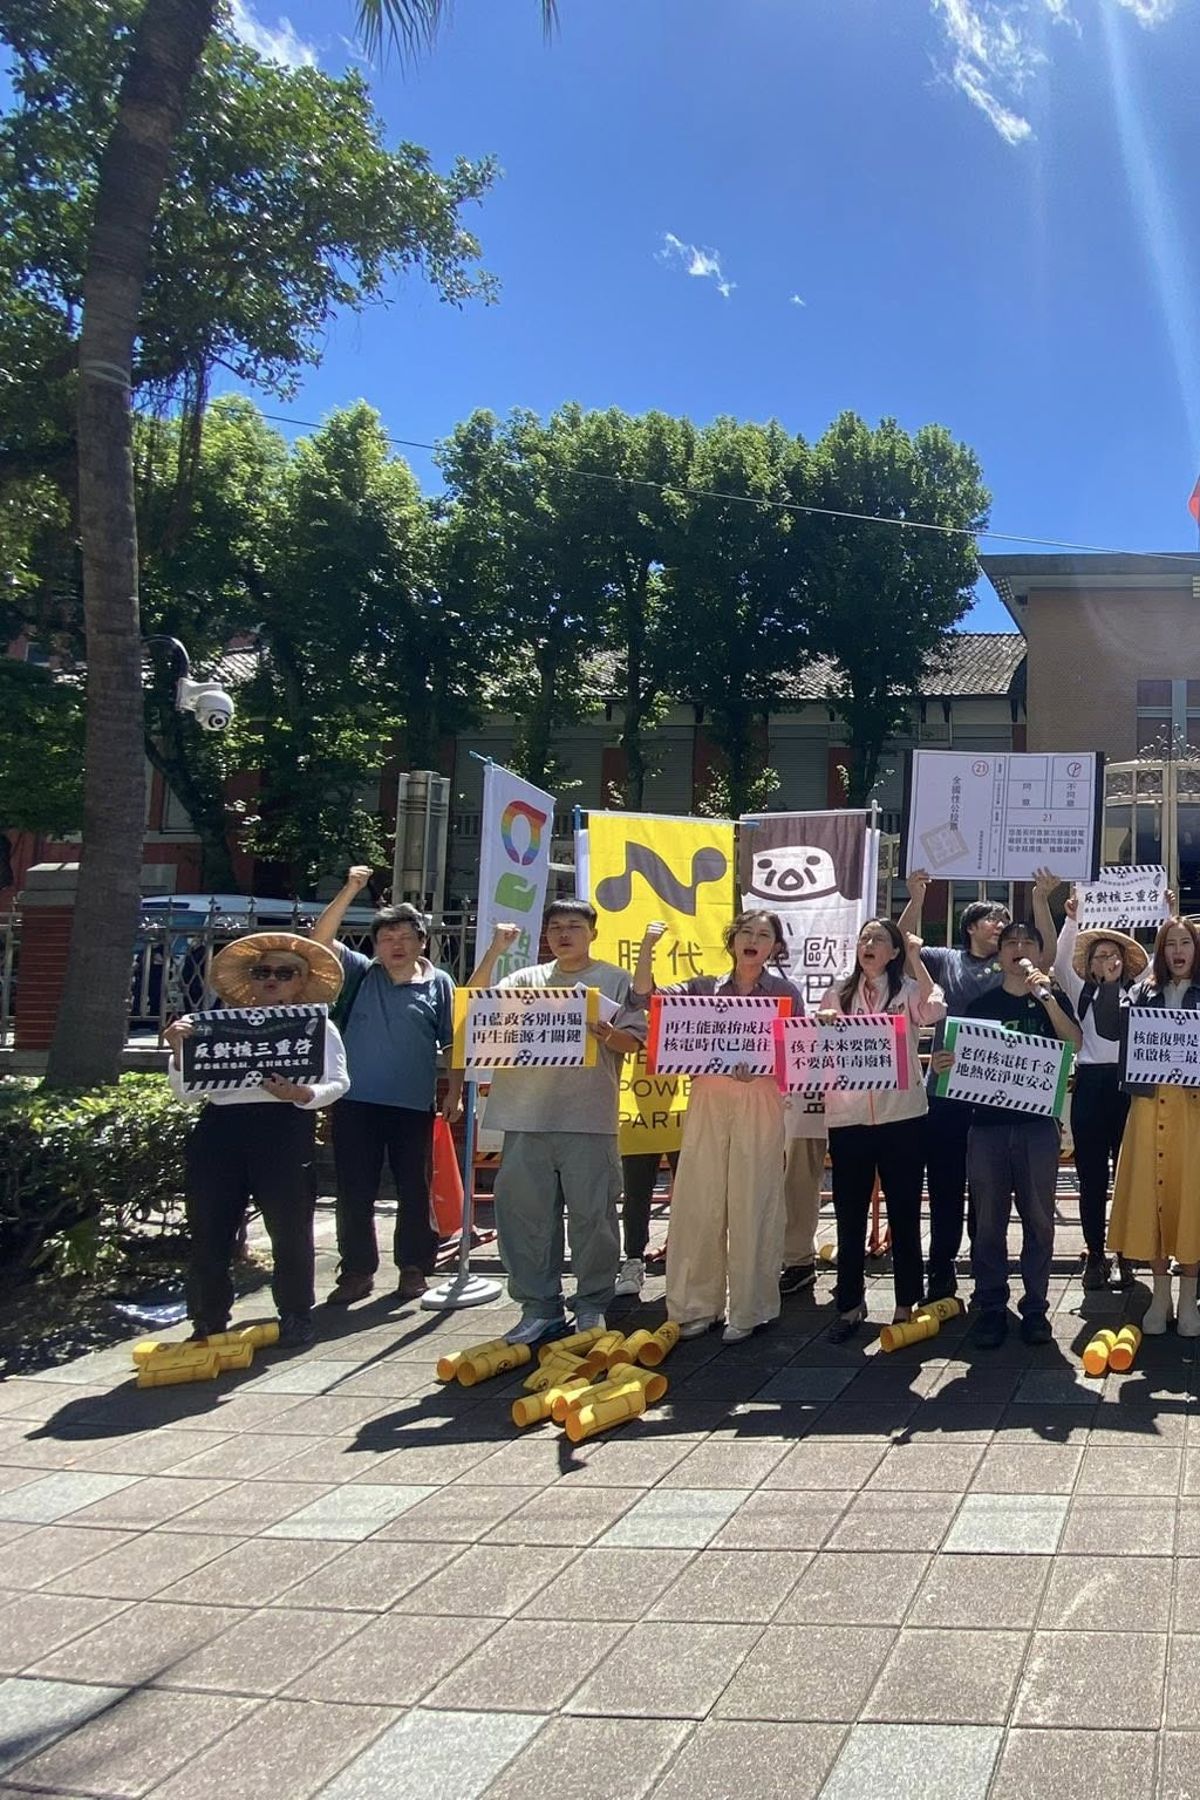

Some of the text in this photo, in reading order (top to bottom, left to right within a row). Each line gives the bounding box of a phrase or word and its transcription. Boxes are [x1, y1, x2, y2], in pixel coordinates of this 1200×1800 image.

[473, 1012, 582, 1026] 白藍政客別再騙
[472, 1029, 581, 1044] 再生能源才關鍵
[664, 1037, 771, 1052] 核電時代已過往
[790, 1038, 892, 1053] 孩子未來要微笑
[792, 1055, 892, 1069] 不要萬年毒廢料
[961, 1046, 1056, 1074] 老舊核電耗千金
[955, 1062, 1053, 1091] 地熱乾淨更安心
[619, 1079, 692, 1098] POWE
[619, 1111, 686, 1129] PART
